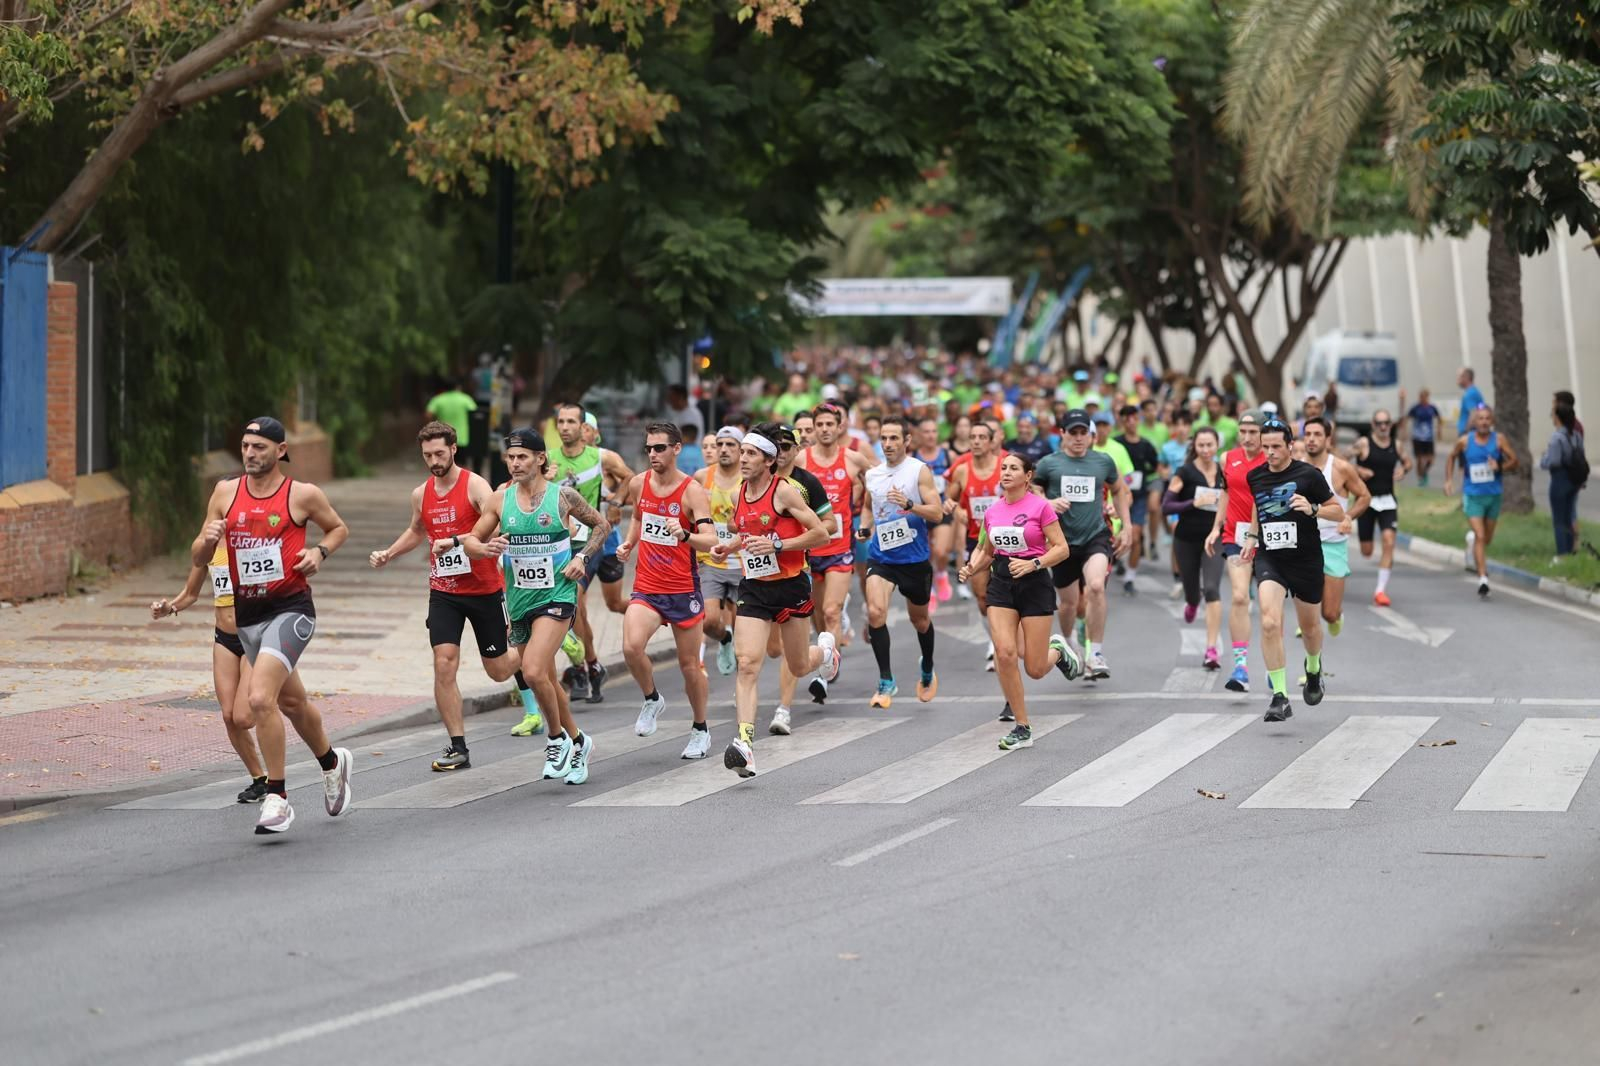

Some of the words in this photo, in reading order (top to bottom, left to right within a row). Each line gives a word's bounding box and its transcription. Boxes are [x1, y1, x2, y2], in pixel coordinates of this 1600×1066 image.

[1065, 484, 1089, 495] 305
[645, 523, 671, 537] 273
[881, 528, 905, 542] 278
[510, 534, 550, 544] ATLETISMO
[994, 536, 1019, 546] 538
[1266, 531, 1289, 542] 931
[505, 544, 558, 555] ORREMOLINOS
[242, 559, 274, 574] 732
[438, 554, 462, 567] 894
[747, 555, 771, 569] 624
[518, 568, 547, 580] 403
